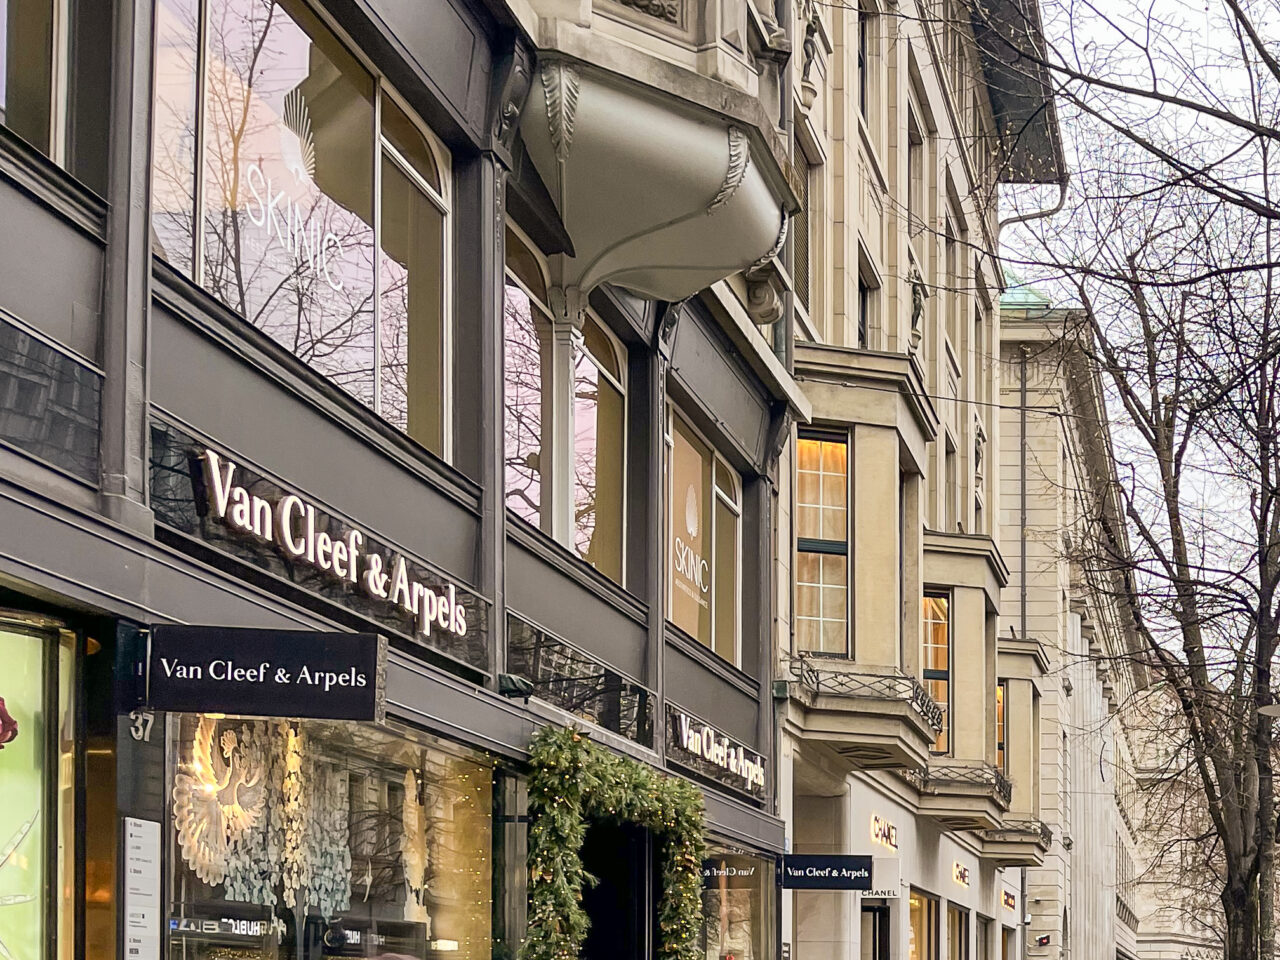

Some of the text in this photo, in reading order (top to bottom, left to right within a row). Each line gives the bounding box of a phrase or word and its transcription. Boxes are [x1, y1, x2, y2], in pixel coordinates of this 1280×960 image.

[245, 164, 344, 291] SKINIC
[206, 449, 467, 636] Van Cleef & Arpels
[675, 537, 708, 593] SKINIC
[161, 658, 367, 692] Van Cleef & Arpels
[130, 711, 155, 742] 37
[681, 713, 764, 790] Van Cleef & Arpels
[787, 867, 869, 880] Van Cleef & Arpels
[861, 889, 897, 897] CHANEL
